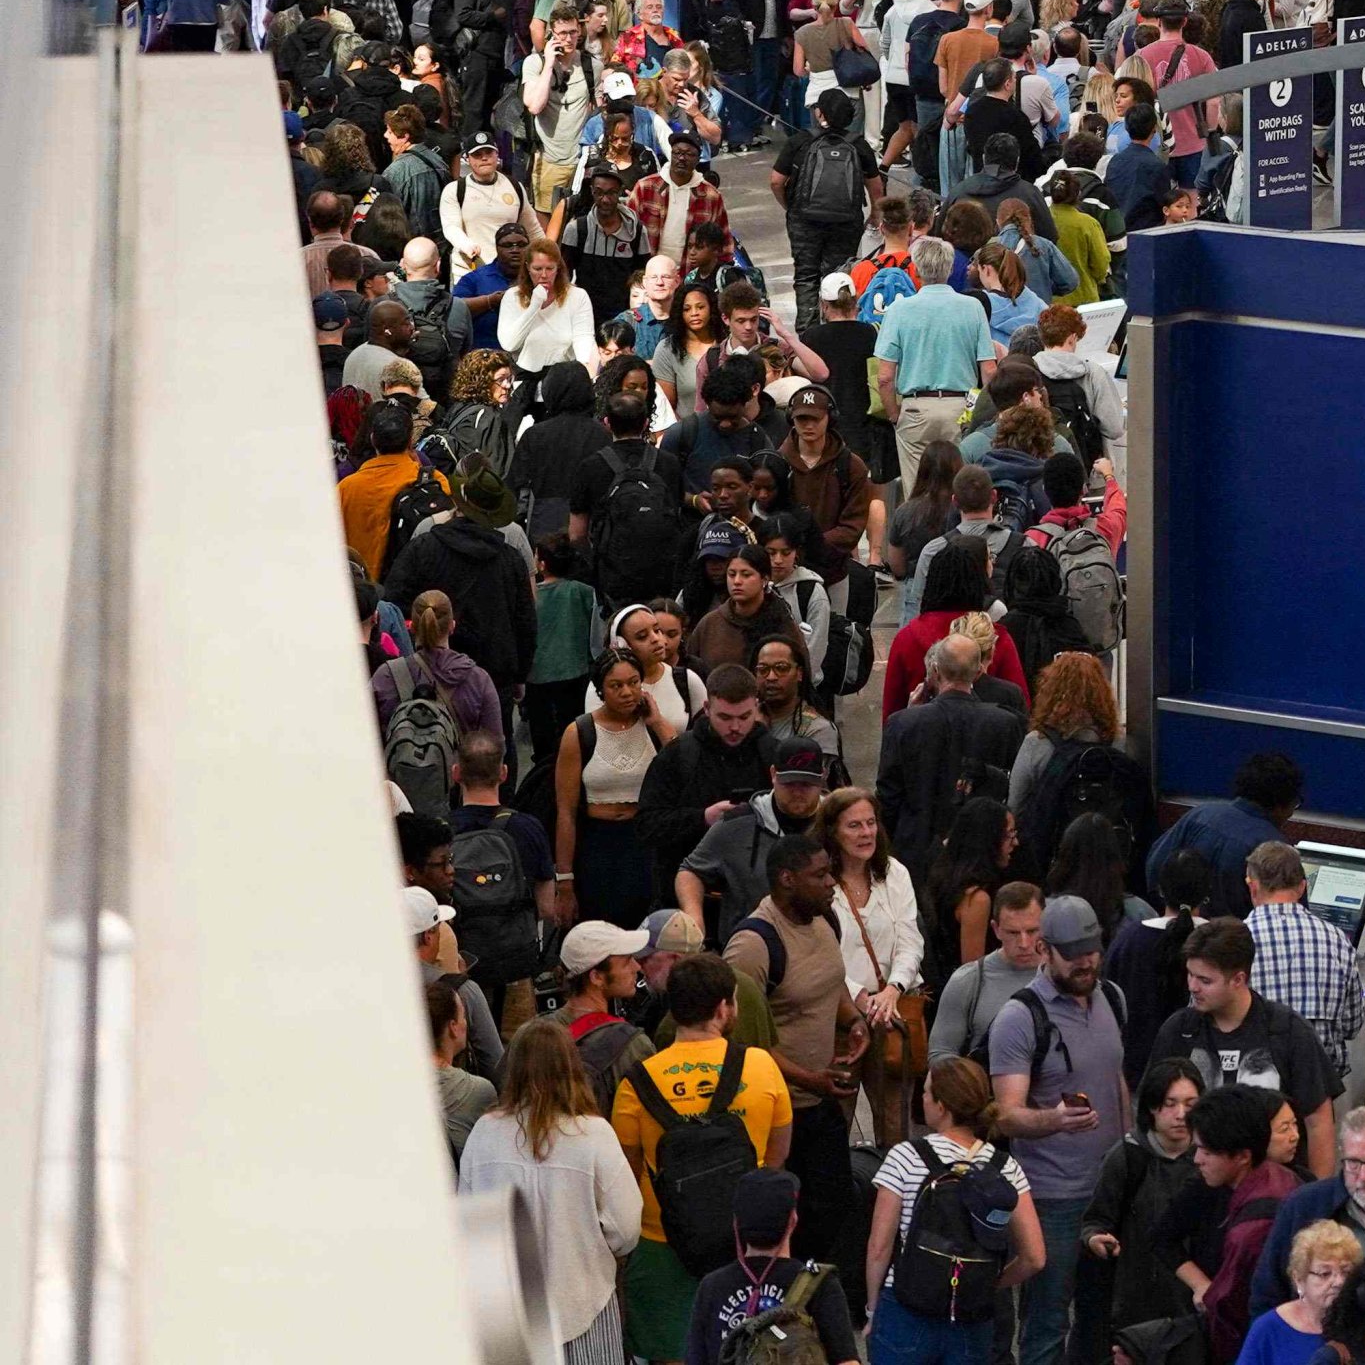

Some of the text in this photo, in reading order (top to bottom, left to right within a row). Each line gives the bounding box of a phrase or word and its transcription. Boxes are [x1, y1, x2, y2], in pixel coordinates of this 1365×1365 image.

[1266, 39, 1297, 52] DELTA
[1276, 80, 1286, 100] 2
[1258, 115, 1303, 130] DROP BAGS
[1265, 128, 1296, 142] WITH ID
[1258, 155, 1290, 167] FOR ACCESS:
[672, 1082, 686, 1096] G
